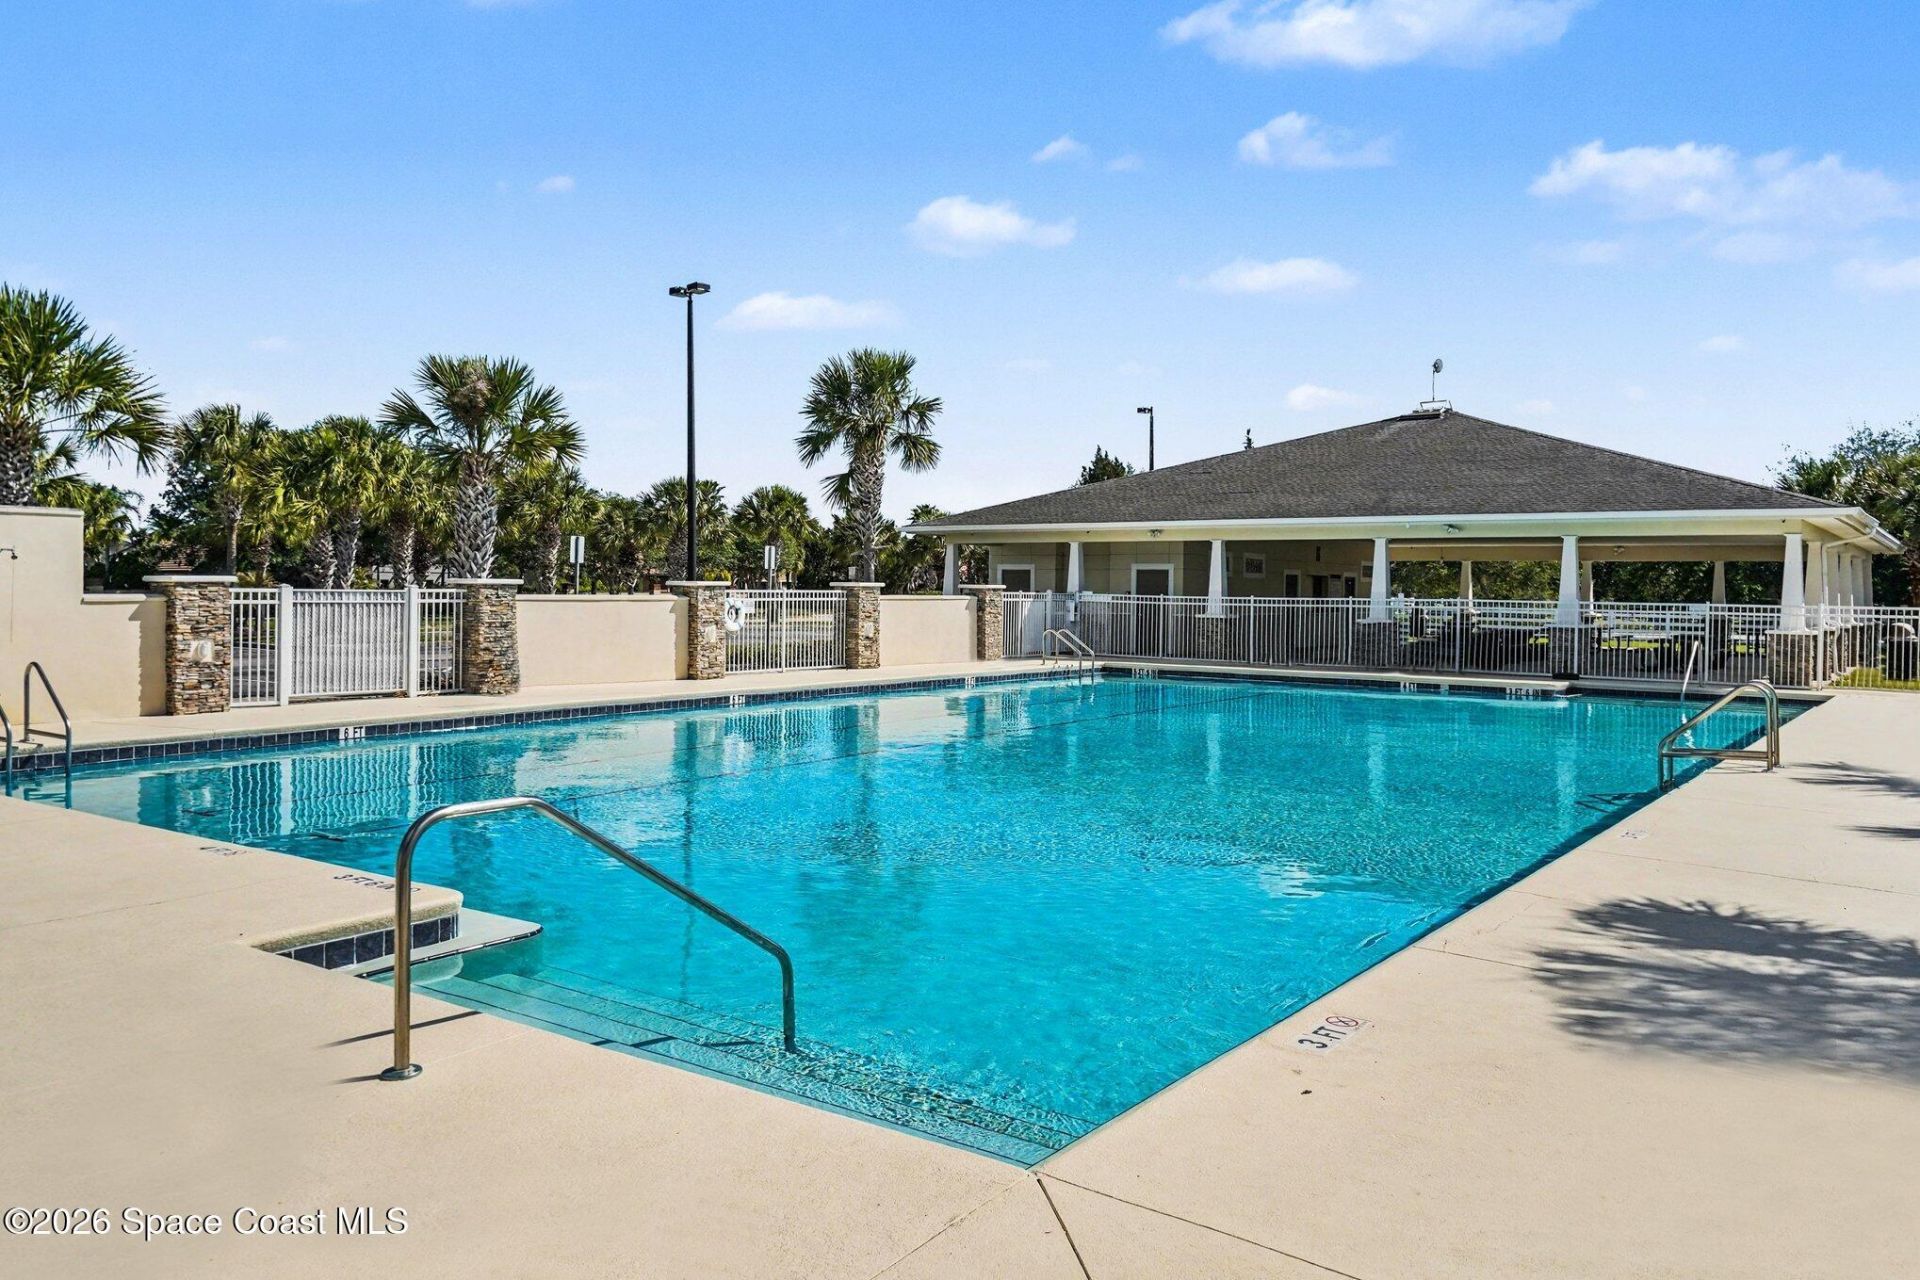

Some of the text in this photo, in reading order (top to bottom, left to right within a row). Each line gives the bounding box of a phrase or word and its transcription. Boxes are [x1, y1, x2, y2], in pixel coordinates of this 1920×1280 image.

[738, 694, 745, 704] FT
[343, 726, 363, 739] 6 FT
[1297, 1025, 1347, 1049] 3 FT
